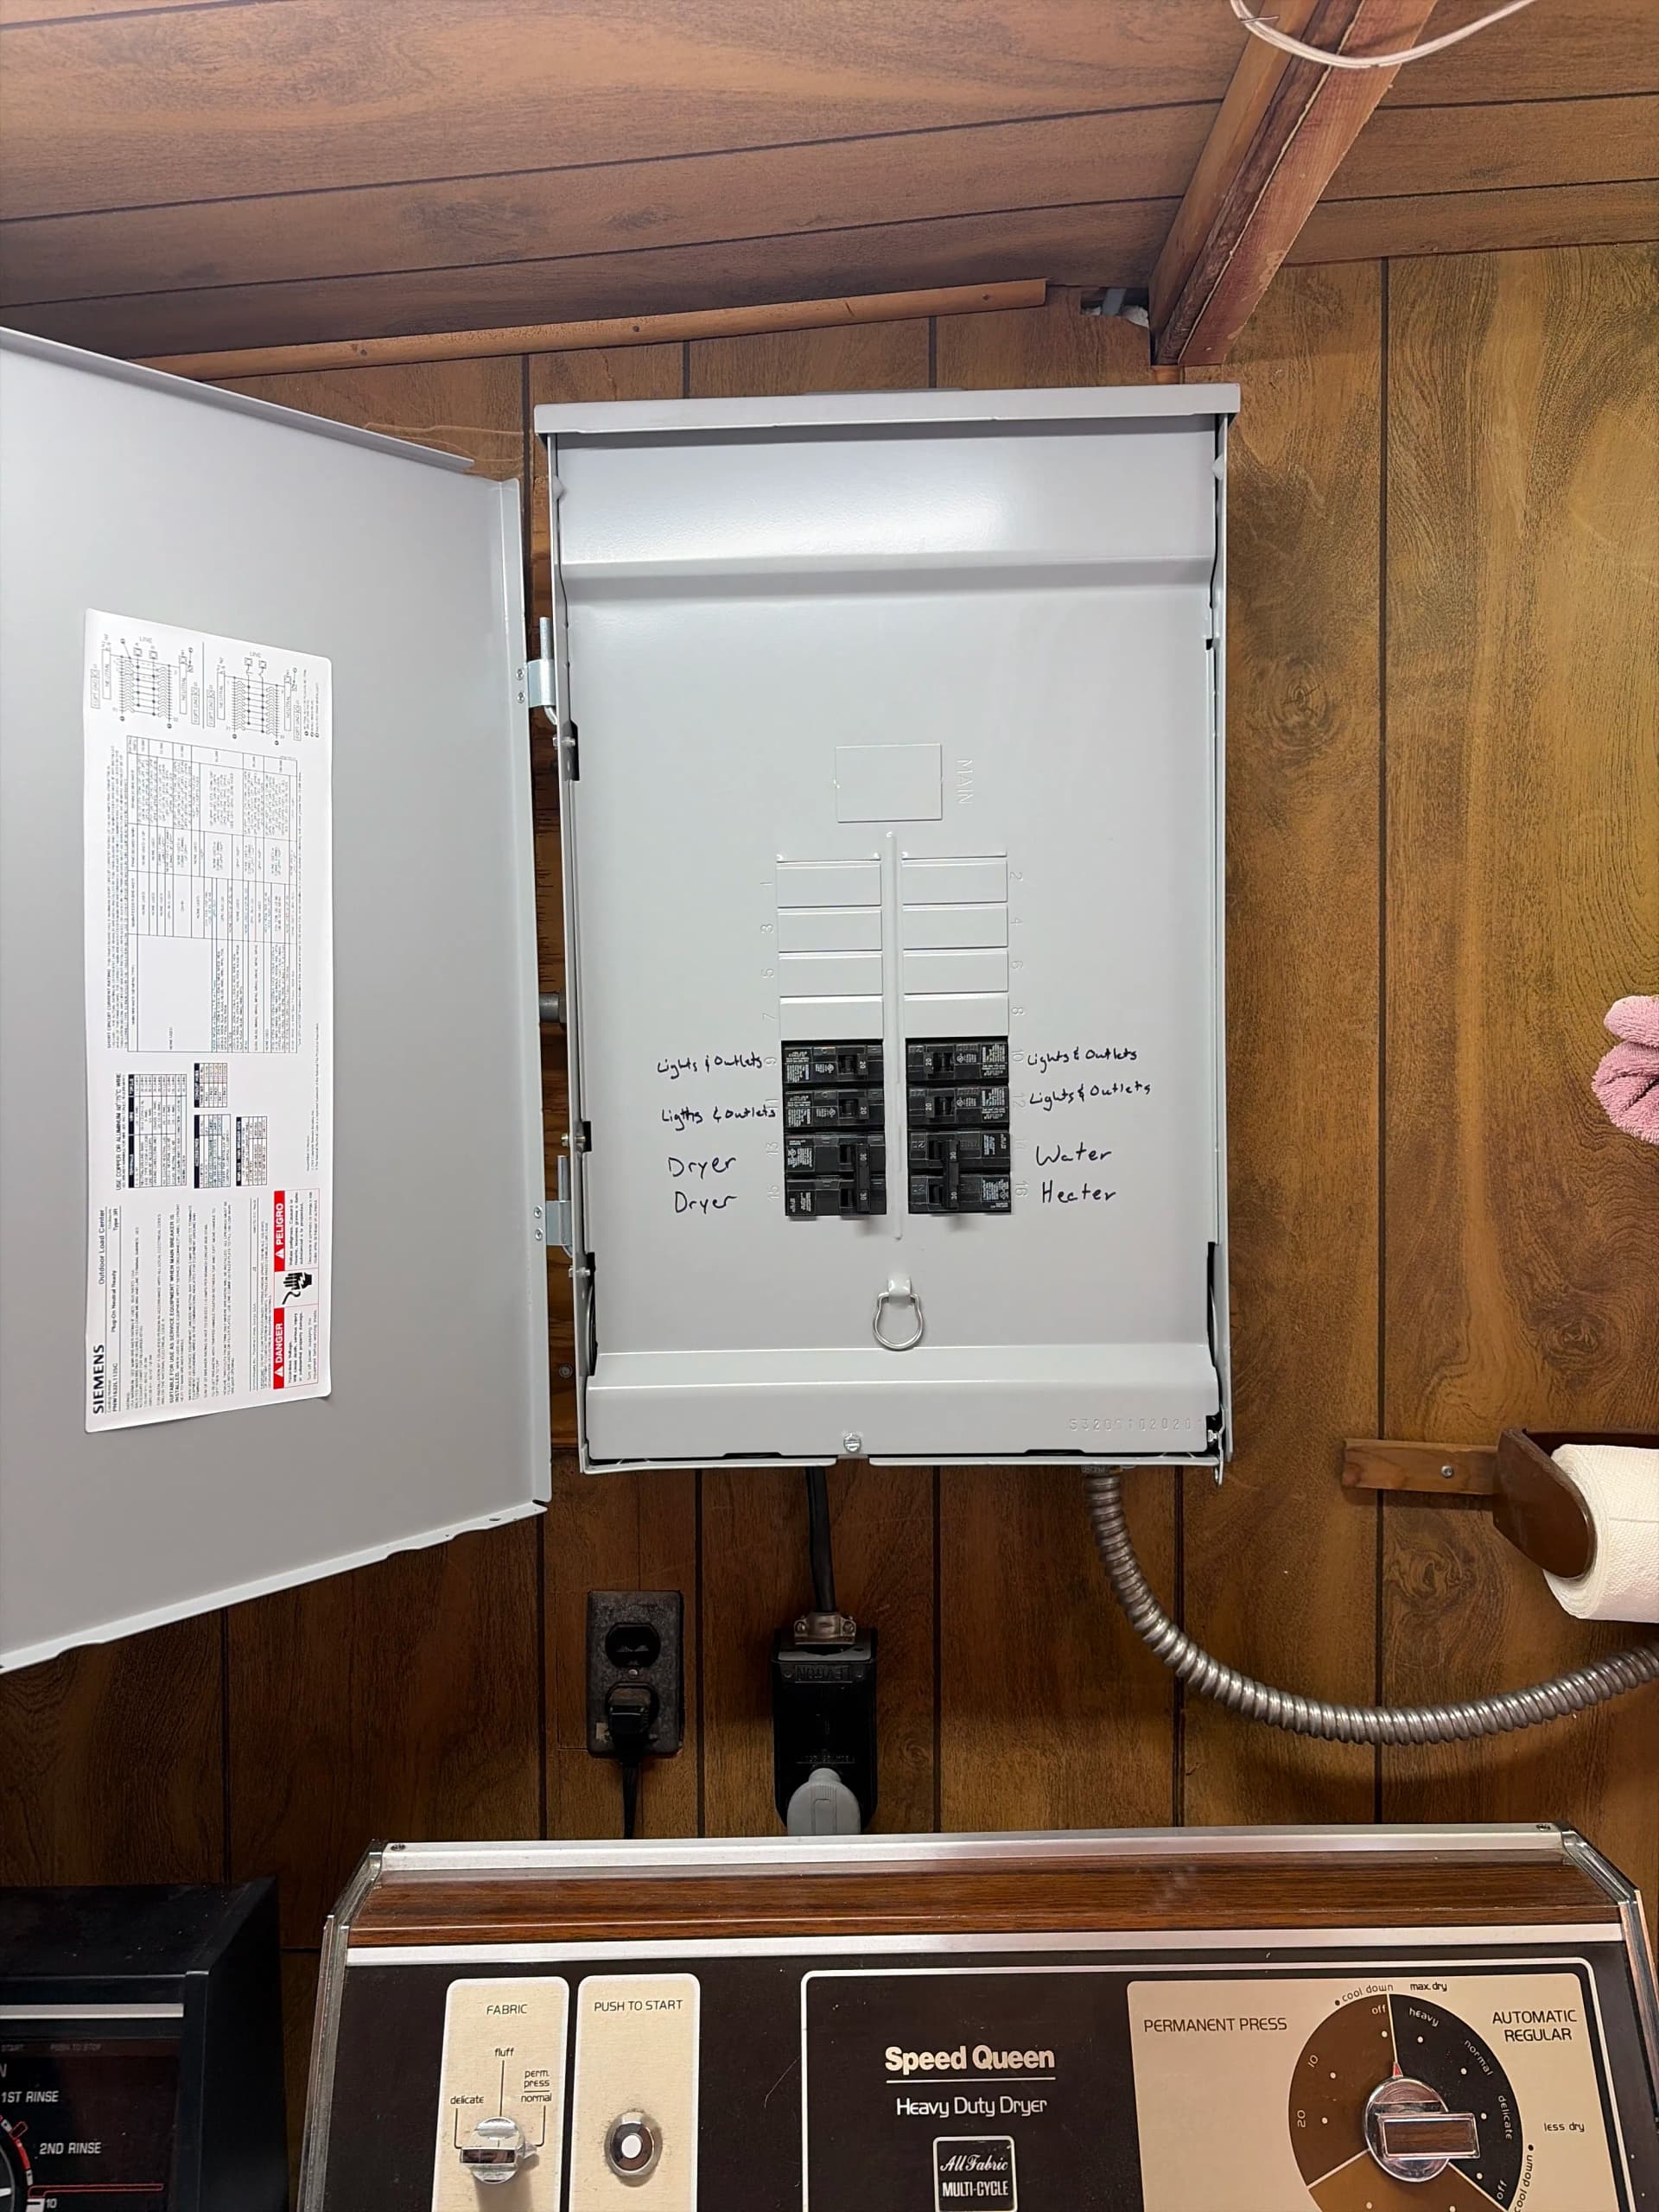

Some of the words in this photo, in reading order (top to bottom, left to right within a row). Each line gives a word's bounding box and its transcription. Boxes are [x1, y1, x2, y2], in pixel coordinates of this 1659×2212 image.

[956, 759, 974, 804] MAIN
[760, 923, 773, 934] 3
[658, 1057, 698, 1079] Lights
[714, 1052, 762, 1069] Outlets
[860, 1061, 867, 1070] 20
[925, 1058, 932, 1066] 20
[1027, 1050, 1070, 1073] Lights
[1085, 1047, 1138, 1060] Outlets
[1029, 1088, 1075, 1111] Lights
[1090, 1080, 1151, 1096] Outlets
[725, 1104, 777, 1118] Outlets
[860, 1106, 868, 1115] 20
[925, 1103, 932, 1111] 20
[115, 1144, 122, 1153] OR
[1036, 1141, 1112, 1166] Water
[668, 1157, 737, 1179] Dryer
[1042, 1179, 1116, 1203] Heater
[675, 1191, 738, 1215] Dryer
[276, 1203, 284, 1246] PELIGRO
[275, 1323, 283, 1363] DANGER
[92, 1344, 105, 1414] SIEMENS
[1341, 1988, 1363, 2002] cool
[1366, 1983, 1393, 1993] down
[1432, 1981, 1447, 1993] dry
[486, 2004, 528, 2015] FABRIC
[594, 2001, 625, 2012] PUSH
[627, 2000, 643, 2011] TO
[645, 1999, 683, 2011] START
[1371, 2005, 1386, 2014] off
[1144, 2018, 1236, 2032] PERMANENT
[1239, 2017, 1287, 2031] PRESS
[1408, 2006, 1440, 2028] heavy
[1492, 2009, 1578, 2025] AUTOMATIC
[1504, 2028, 1573, 2043] REGULAR
[494, 2047, 514, 2057] fluff
[885, 2045, 967, 2075] Speed
[972, 2044, 1056, 2071] Queen
[1464, 2039, 1494, 2076] normal
[1307, 2055, 1319, 2069] 10
[524, 2069, 550, 2079] perm.
[524, 2079, 550, 2089] press
[1, 2091, 22, 2103] 1ST
[25, 2090, 60, 2102] RINSE
[450, 2094, 485, 2105] delicate
[521, 2094, 552, 2103] normal
[896, 2097, 950, 2118] Heavy
[954, 2096, 995, 2117] Duty
[1000, 2095, 1048, 2117] Dryer
[1297, 2109, 1306, 2128] 20
[1497, 2094, 1513, 2140] delicate
[1543, 2121, 1566, 2132] less
[1568, 2121, 1585, 2133] dry
[39, 2142, 64, 2155] 2ND
[68, 2141, 102, 2154] RINSE
[942, 2180, 1009, 2197] MULTI-CYCLE
[1497, 2179, 1508, 2201] off
[1514, 2188, 1528, 2212] cool
[1523, 2154, 1534, 2187] down
[46, 2198, 57, 2209] 10
